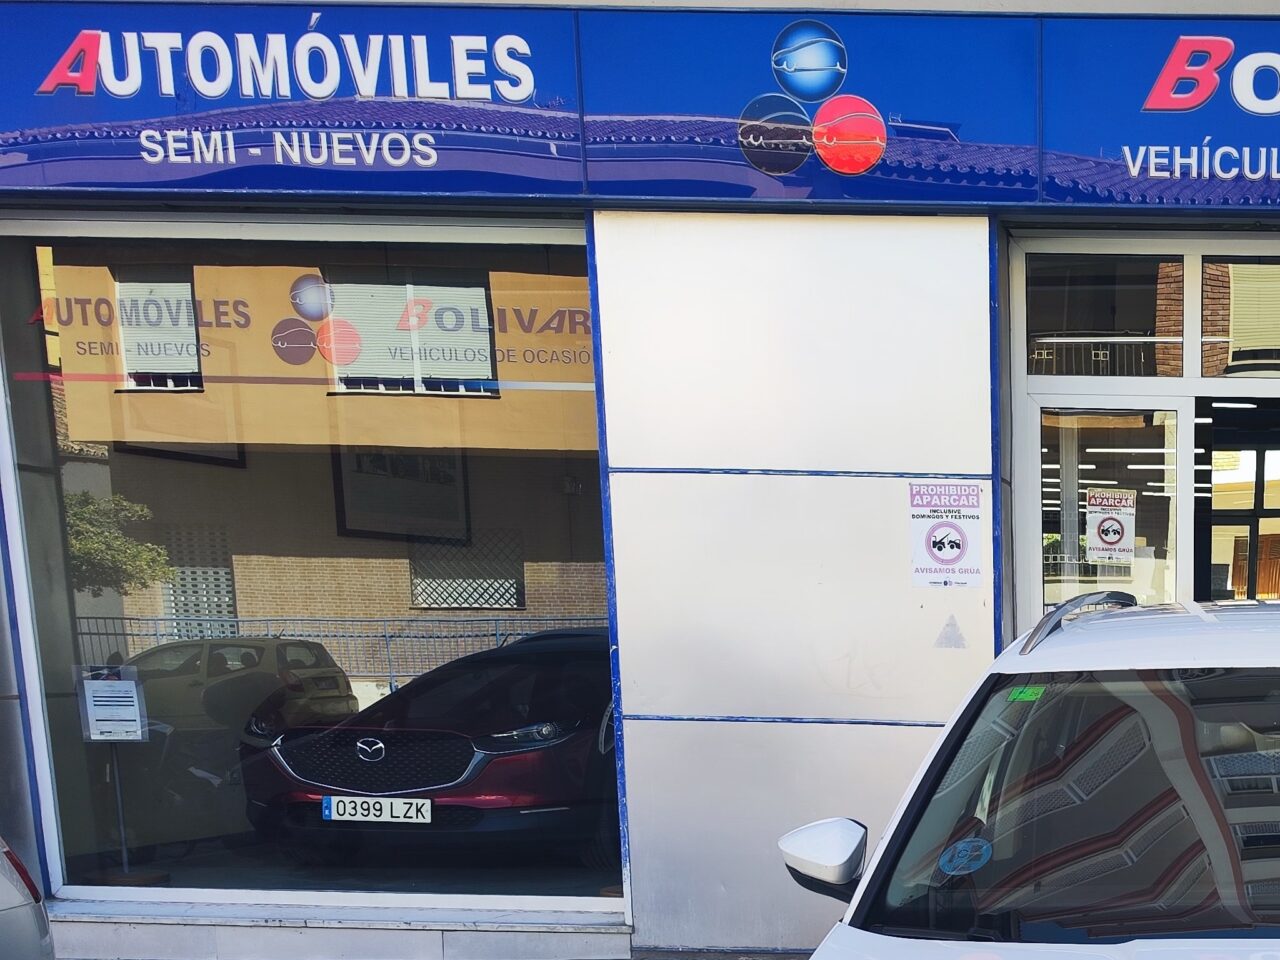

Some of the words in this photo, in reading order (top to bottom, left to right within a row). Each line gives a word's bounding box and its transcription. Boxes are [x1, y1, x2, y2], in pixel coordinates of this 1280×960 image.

[35, 13, 536, 102] AUTOMÓVILES
[139, 129, 236, 165] SEMI
[274, 131, 439, 168] NUEVOS
[27, 288, 252, 329] AUTOMÓVILES
[75, 340, 120, 357] SEMI
[136, 342, 212, 358] NUEVOS
[495, 347, 518, 363] DE
[522, 345, 592, 365] OCASIÓ
[912, 485, 978, 496] PROHIBIDO
[912, 495, 978, 506] APARCAR
[1089, 497, 1134, 507] APARCAR
[336, 799, 384, 819] 0399
[390, 801, 427, 820] LZK
